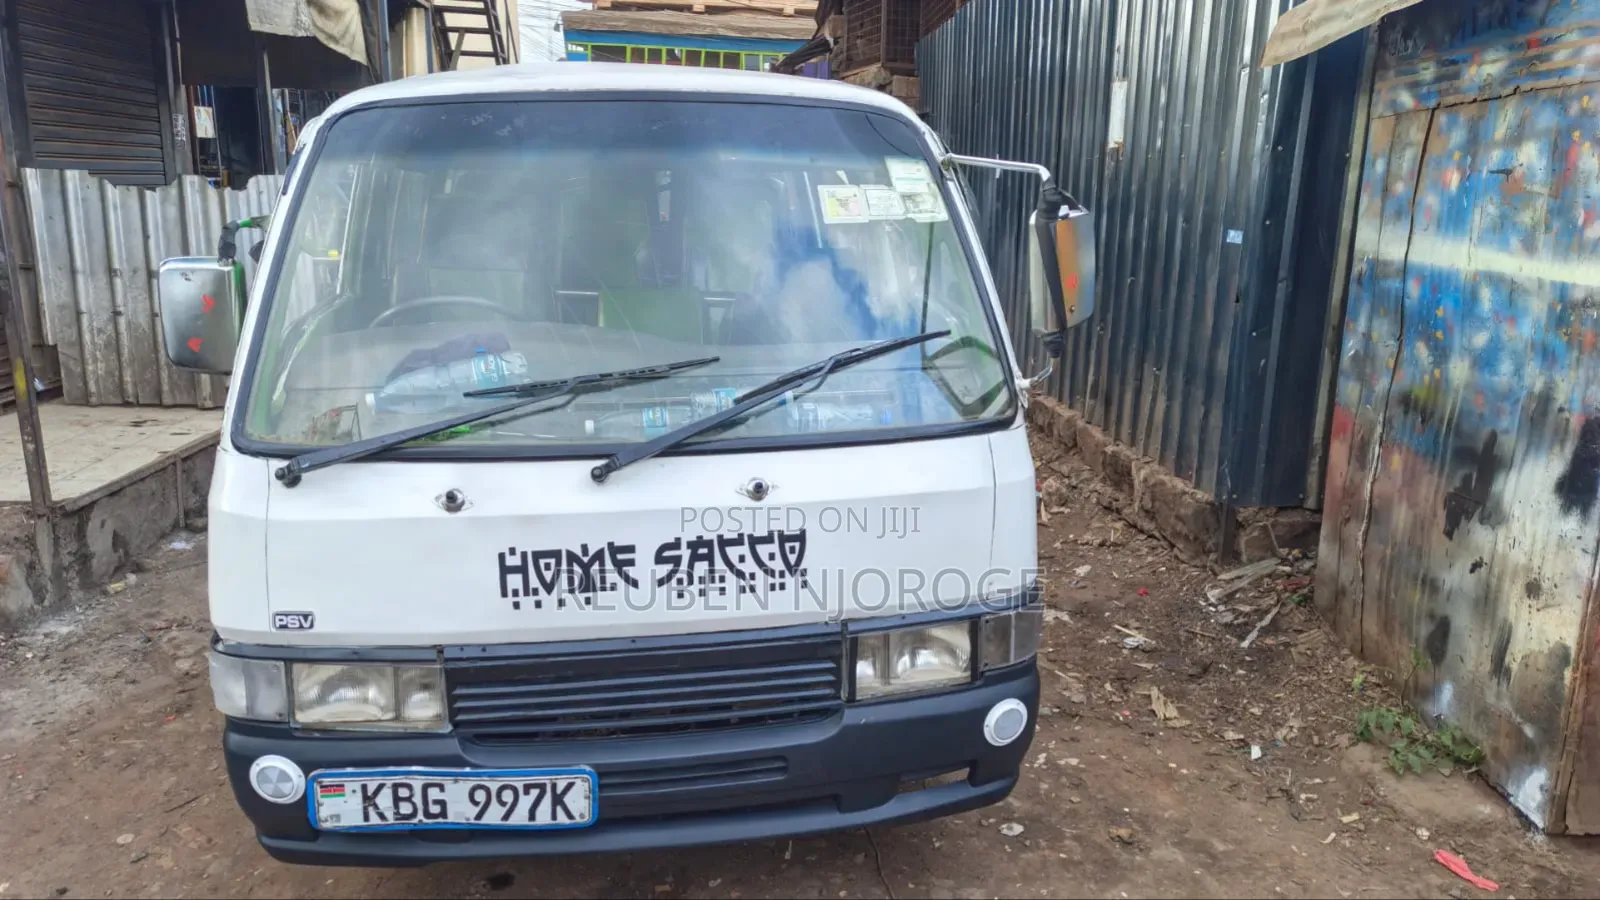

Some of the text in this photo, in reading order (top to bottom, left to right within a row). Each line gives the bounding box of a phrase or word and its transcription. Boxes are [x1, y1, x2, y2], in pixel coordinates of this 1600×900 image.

[497, 529, 808, 610] HOME SACCO
[275, 615, 313, 628] PSV
[361, 781, 577, 822] KBG 997K
